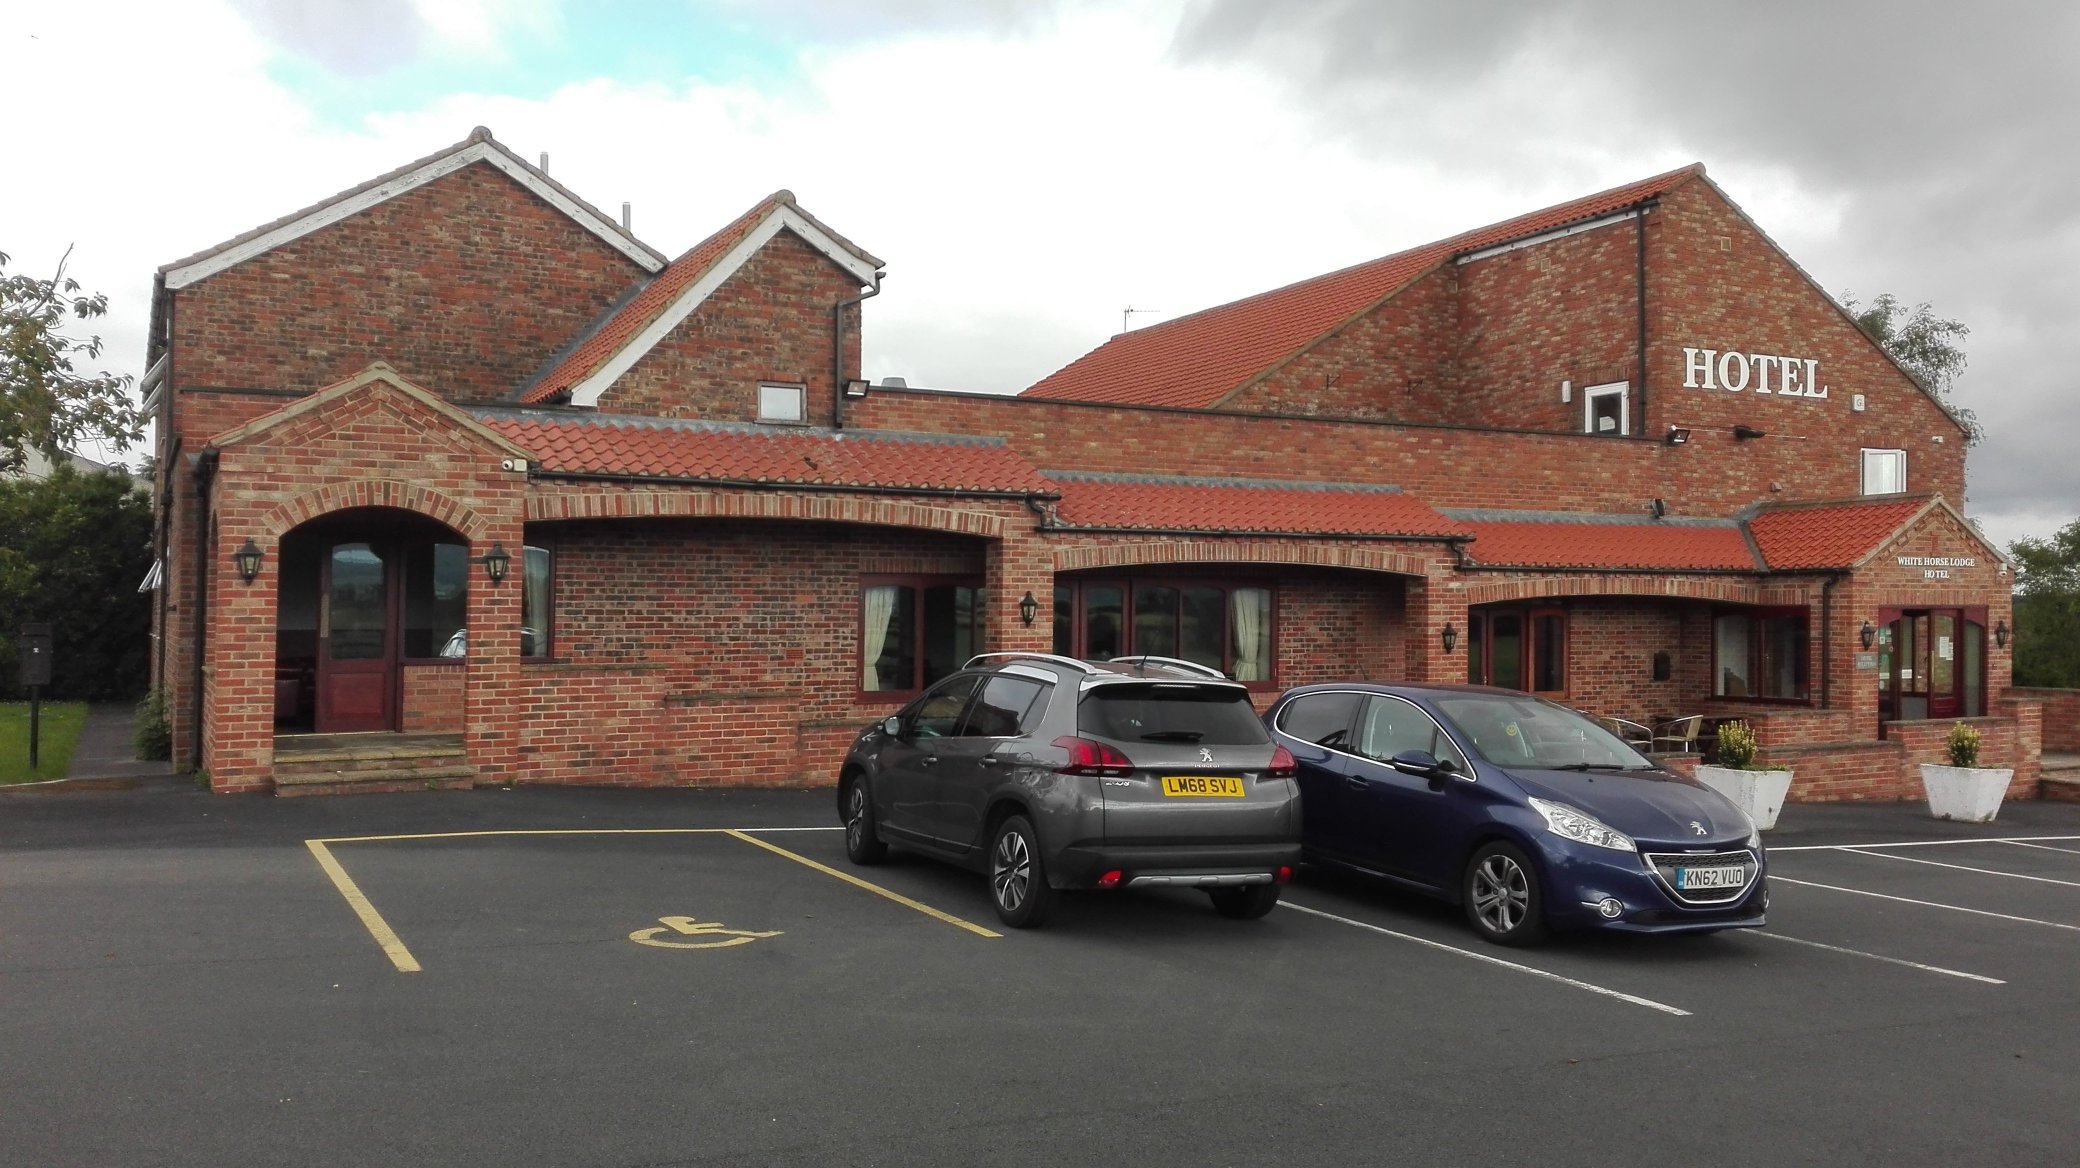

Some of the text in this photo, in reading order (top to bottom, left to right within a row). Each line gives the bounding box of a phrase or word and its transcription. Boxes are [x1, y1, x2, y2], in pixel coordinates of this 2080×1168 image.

[1683, 347, 1828, 398] HOTEL
[1898, 556, 1975, 567] WHITE HORSE LODGE
[1924, 569, 1950, 579] HOTEL
[1168, 778, 1238, 793] LM68 SVJ
[1686, 869, 1743, 886] KN62 VUO
